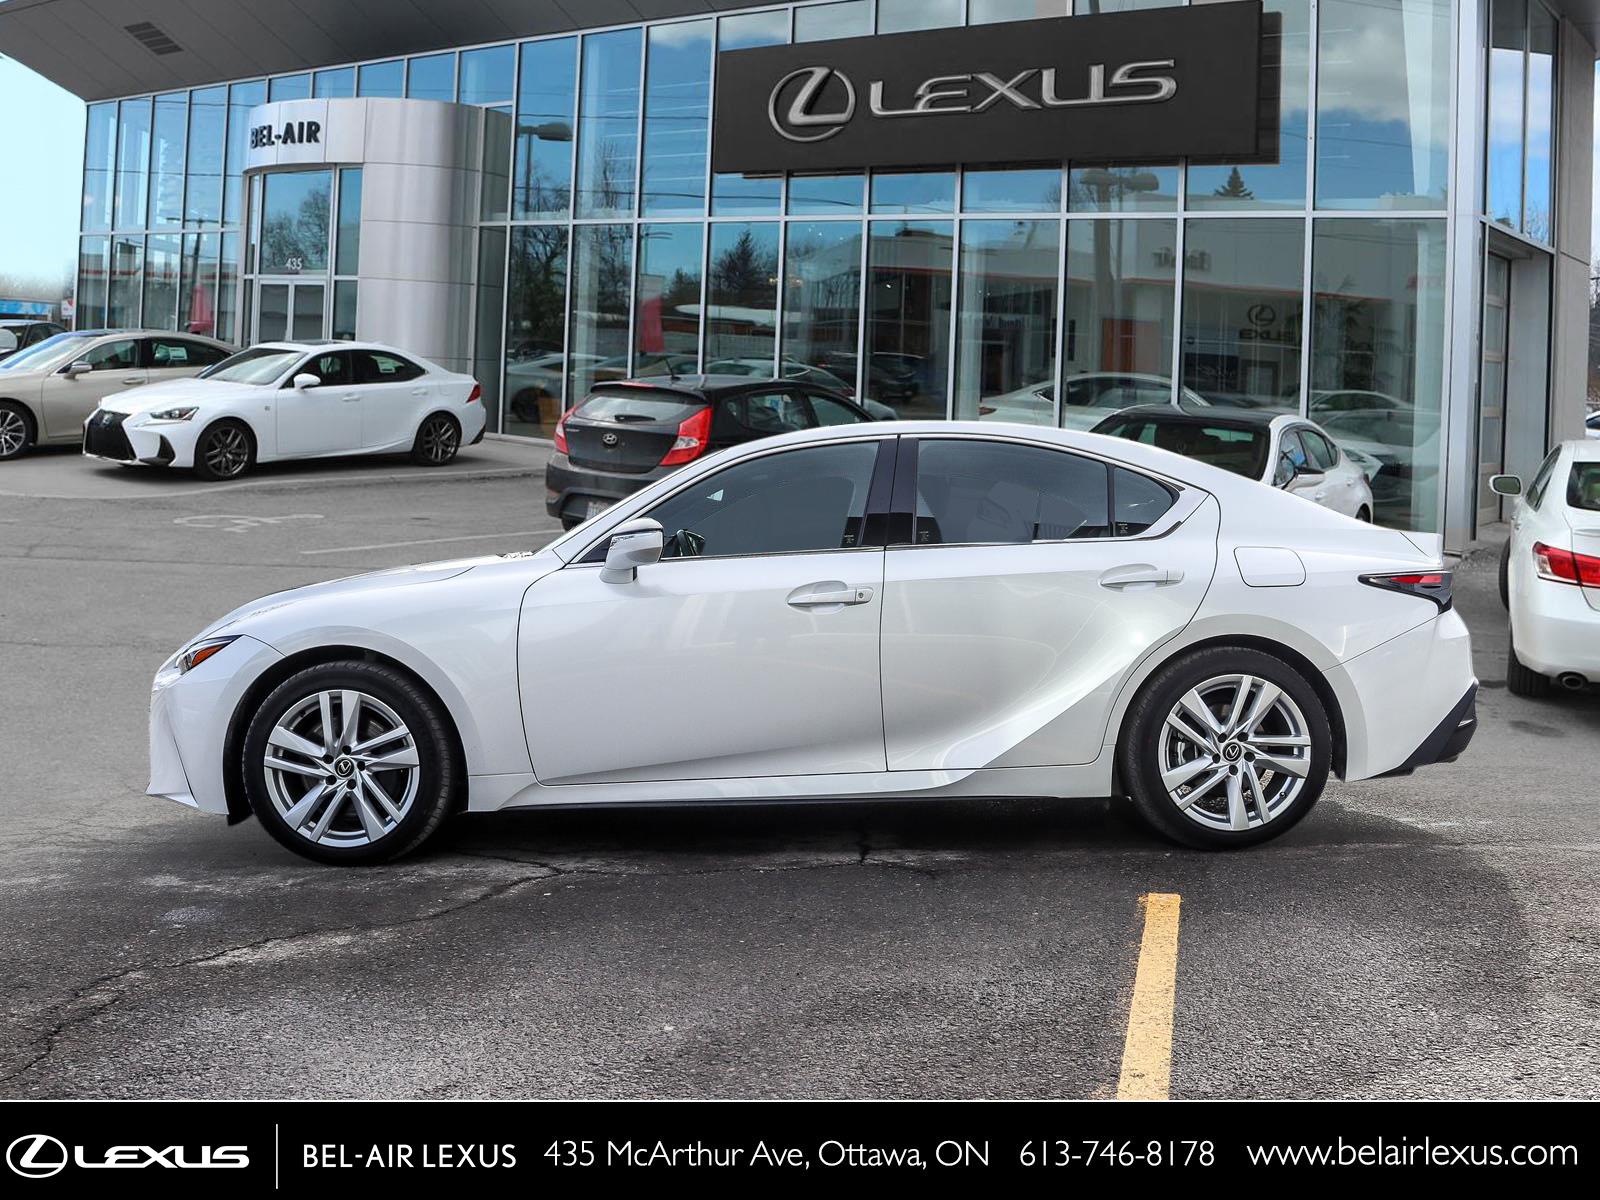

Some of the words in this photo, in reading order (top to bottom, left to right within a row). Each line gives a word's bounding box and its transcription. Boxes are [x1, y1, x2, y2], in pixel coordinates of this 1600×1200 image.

[870, 59, 1177, 116] LEXUS
[250, 120, 321, 149] BEL-AIR
[285, 257, 302, 270] 435
